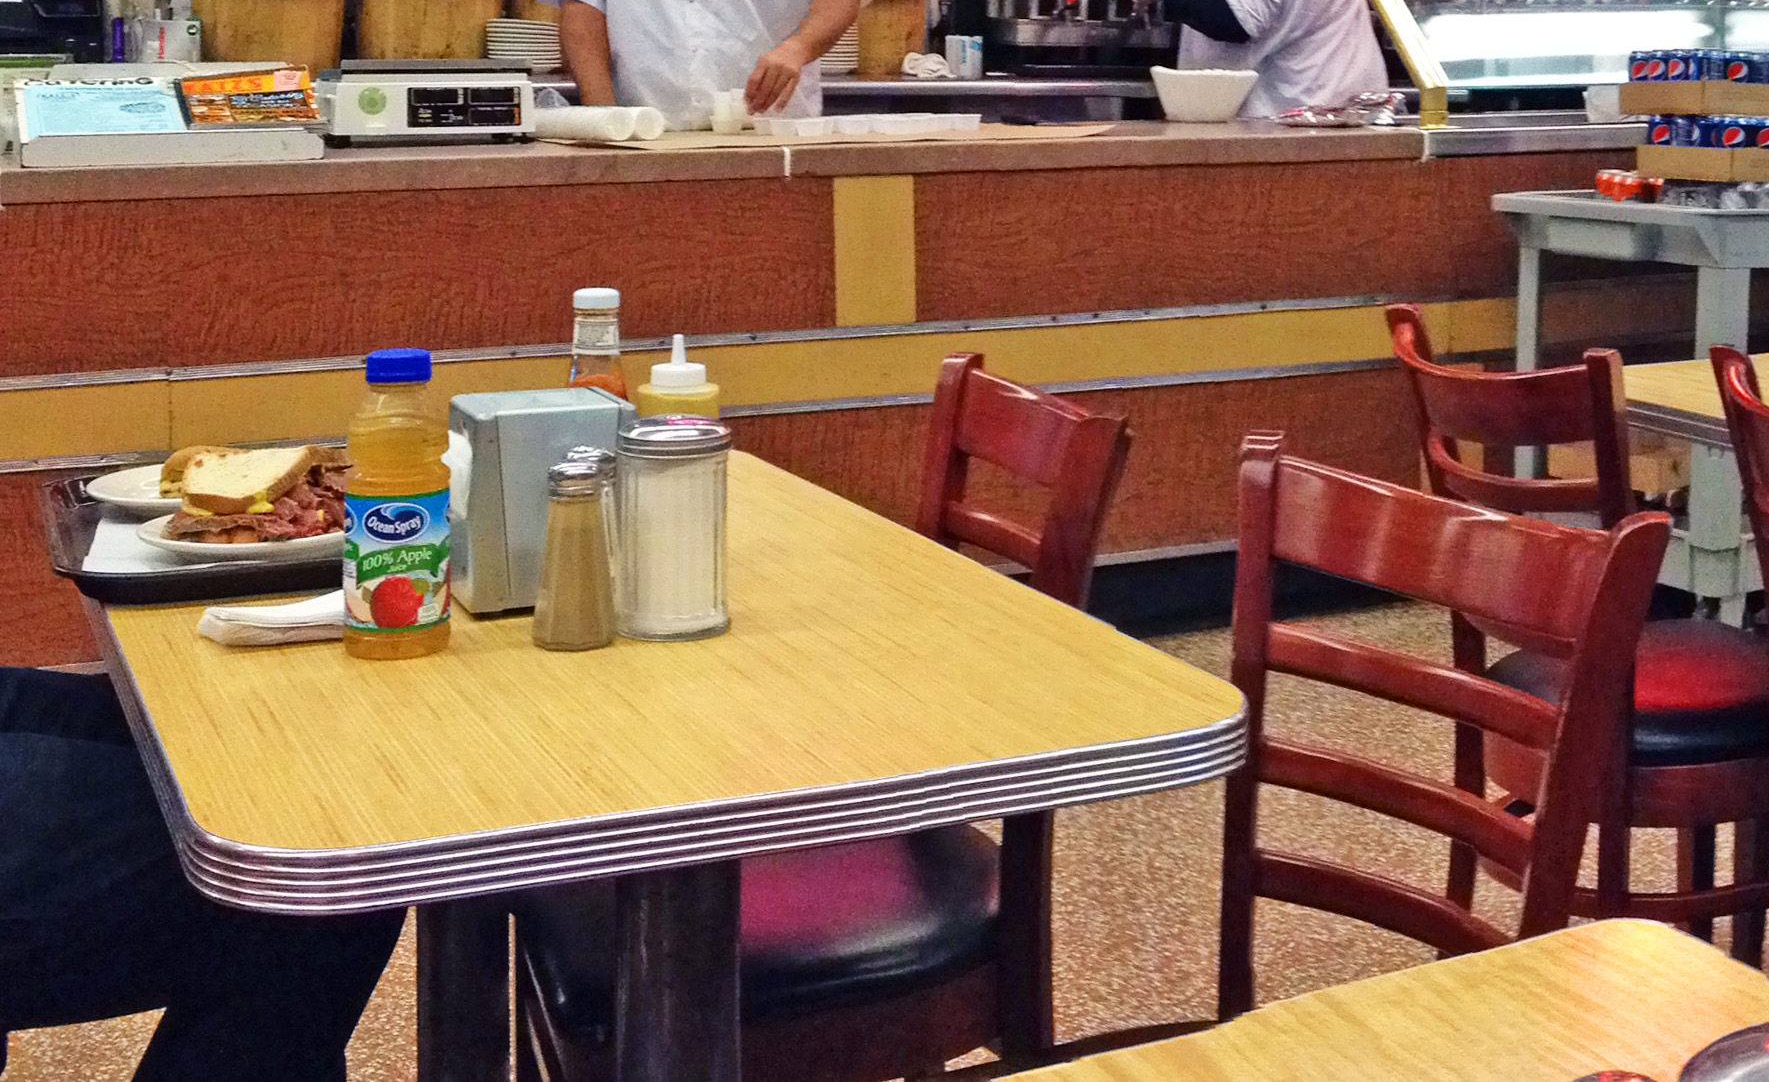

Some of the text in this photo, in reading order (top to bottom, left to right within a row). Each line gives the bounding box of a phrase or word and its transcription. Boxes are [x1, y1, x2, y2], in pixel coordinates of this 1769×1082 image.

[367, 515, 421, 536] Ocean Spray
[362, 548, 433, 571] 100% Apple
